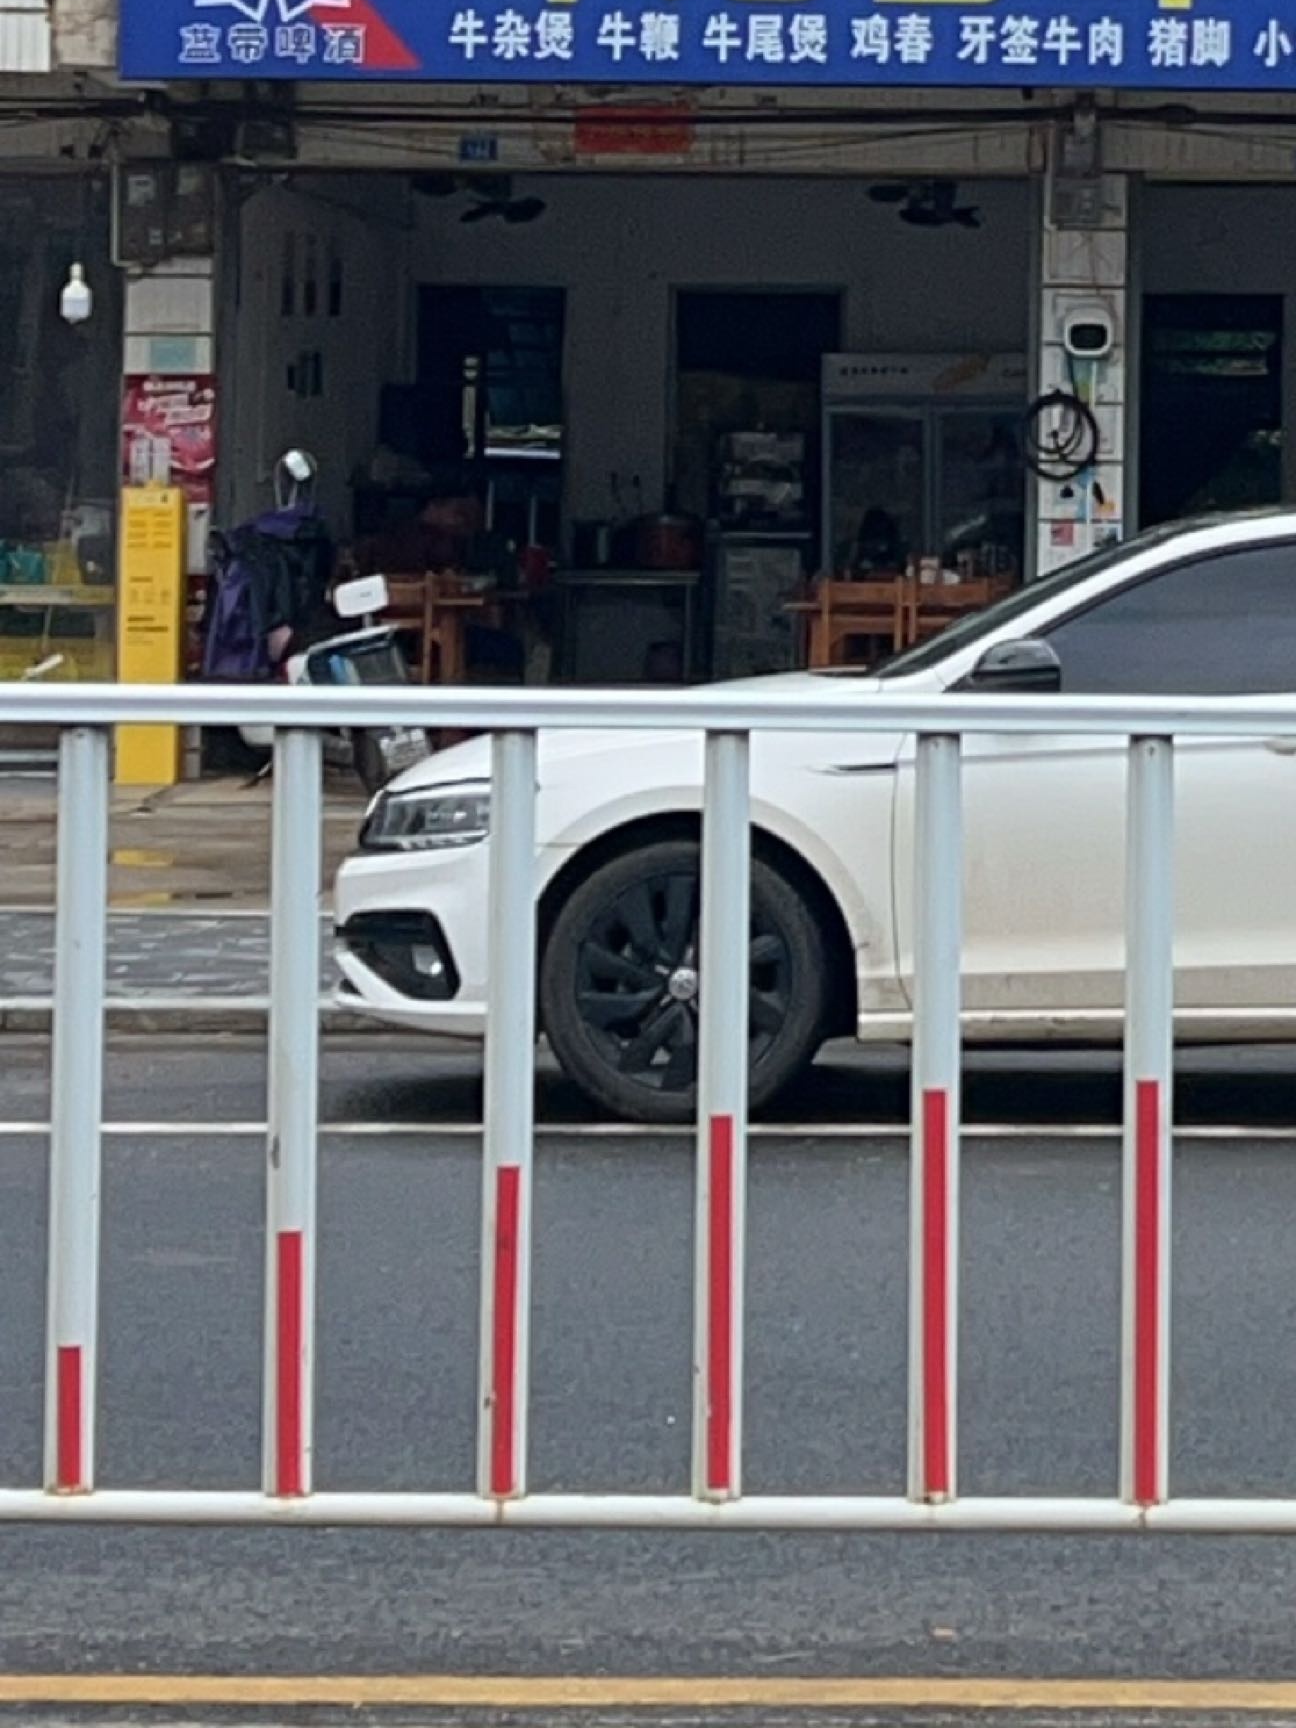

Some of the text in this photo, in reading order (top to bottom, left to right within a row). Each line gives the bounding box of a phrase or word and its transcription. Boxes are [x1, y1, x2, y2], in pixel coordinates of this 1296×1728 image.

[449, 9, 574, 60] 牛杂煲
[597, 11, 680, 61] 牛鞭
[703, 12, 828, 63] 牛尾煲
[850, 13, 932, 64] 鸡春
[957, 15, 1124, 66] 牙签牛肉
[1148, 17, 1231, 67] 猪脚
